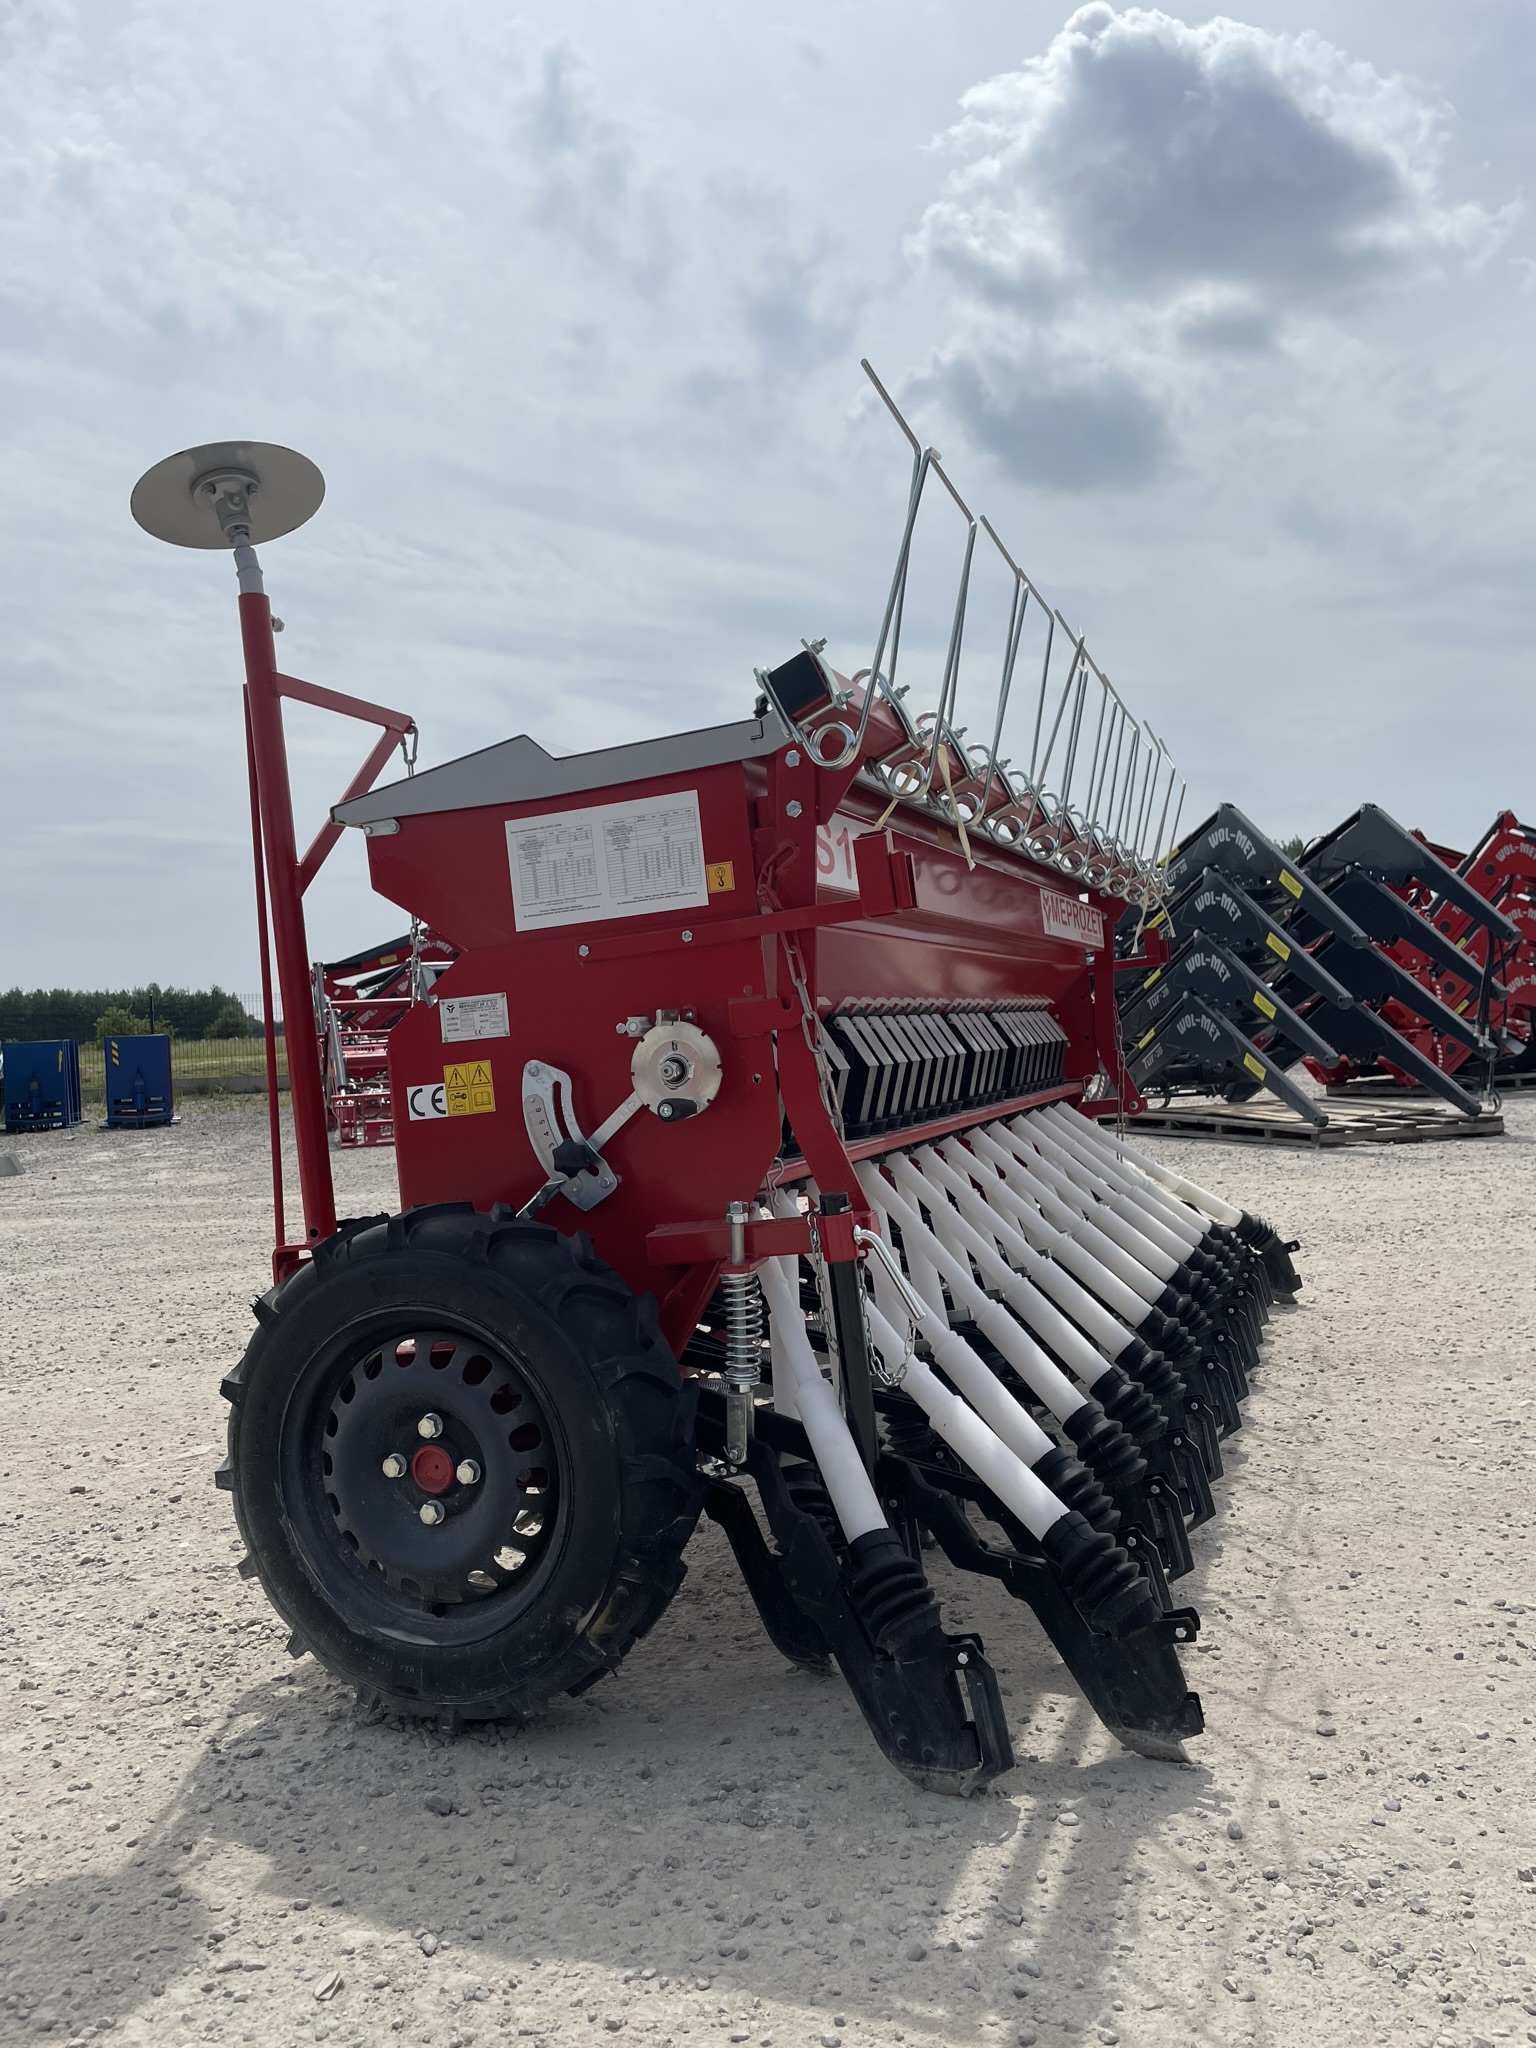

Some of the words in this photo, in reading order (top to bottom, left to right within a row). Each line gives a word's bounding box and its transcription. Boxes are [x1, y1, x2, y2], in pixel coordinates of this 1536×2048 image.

[1208, 827, 1257, 860] WOL-MET
[1050, 895, 1102, 935] MEPROZET
[1194, 891, 1242, 922] WOL-MET
[1185, 952, 1231, 983] WOL-MET
[1176, 1013, 1221, 1042] WOL-MET
[410, 1085, 447, 1117] CE
